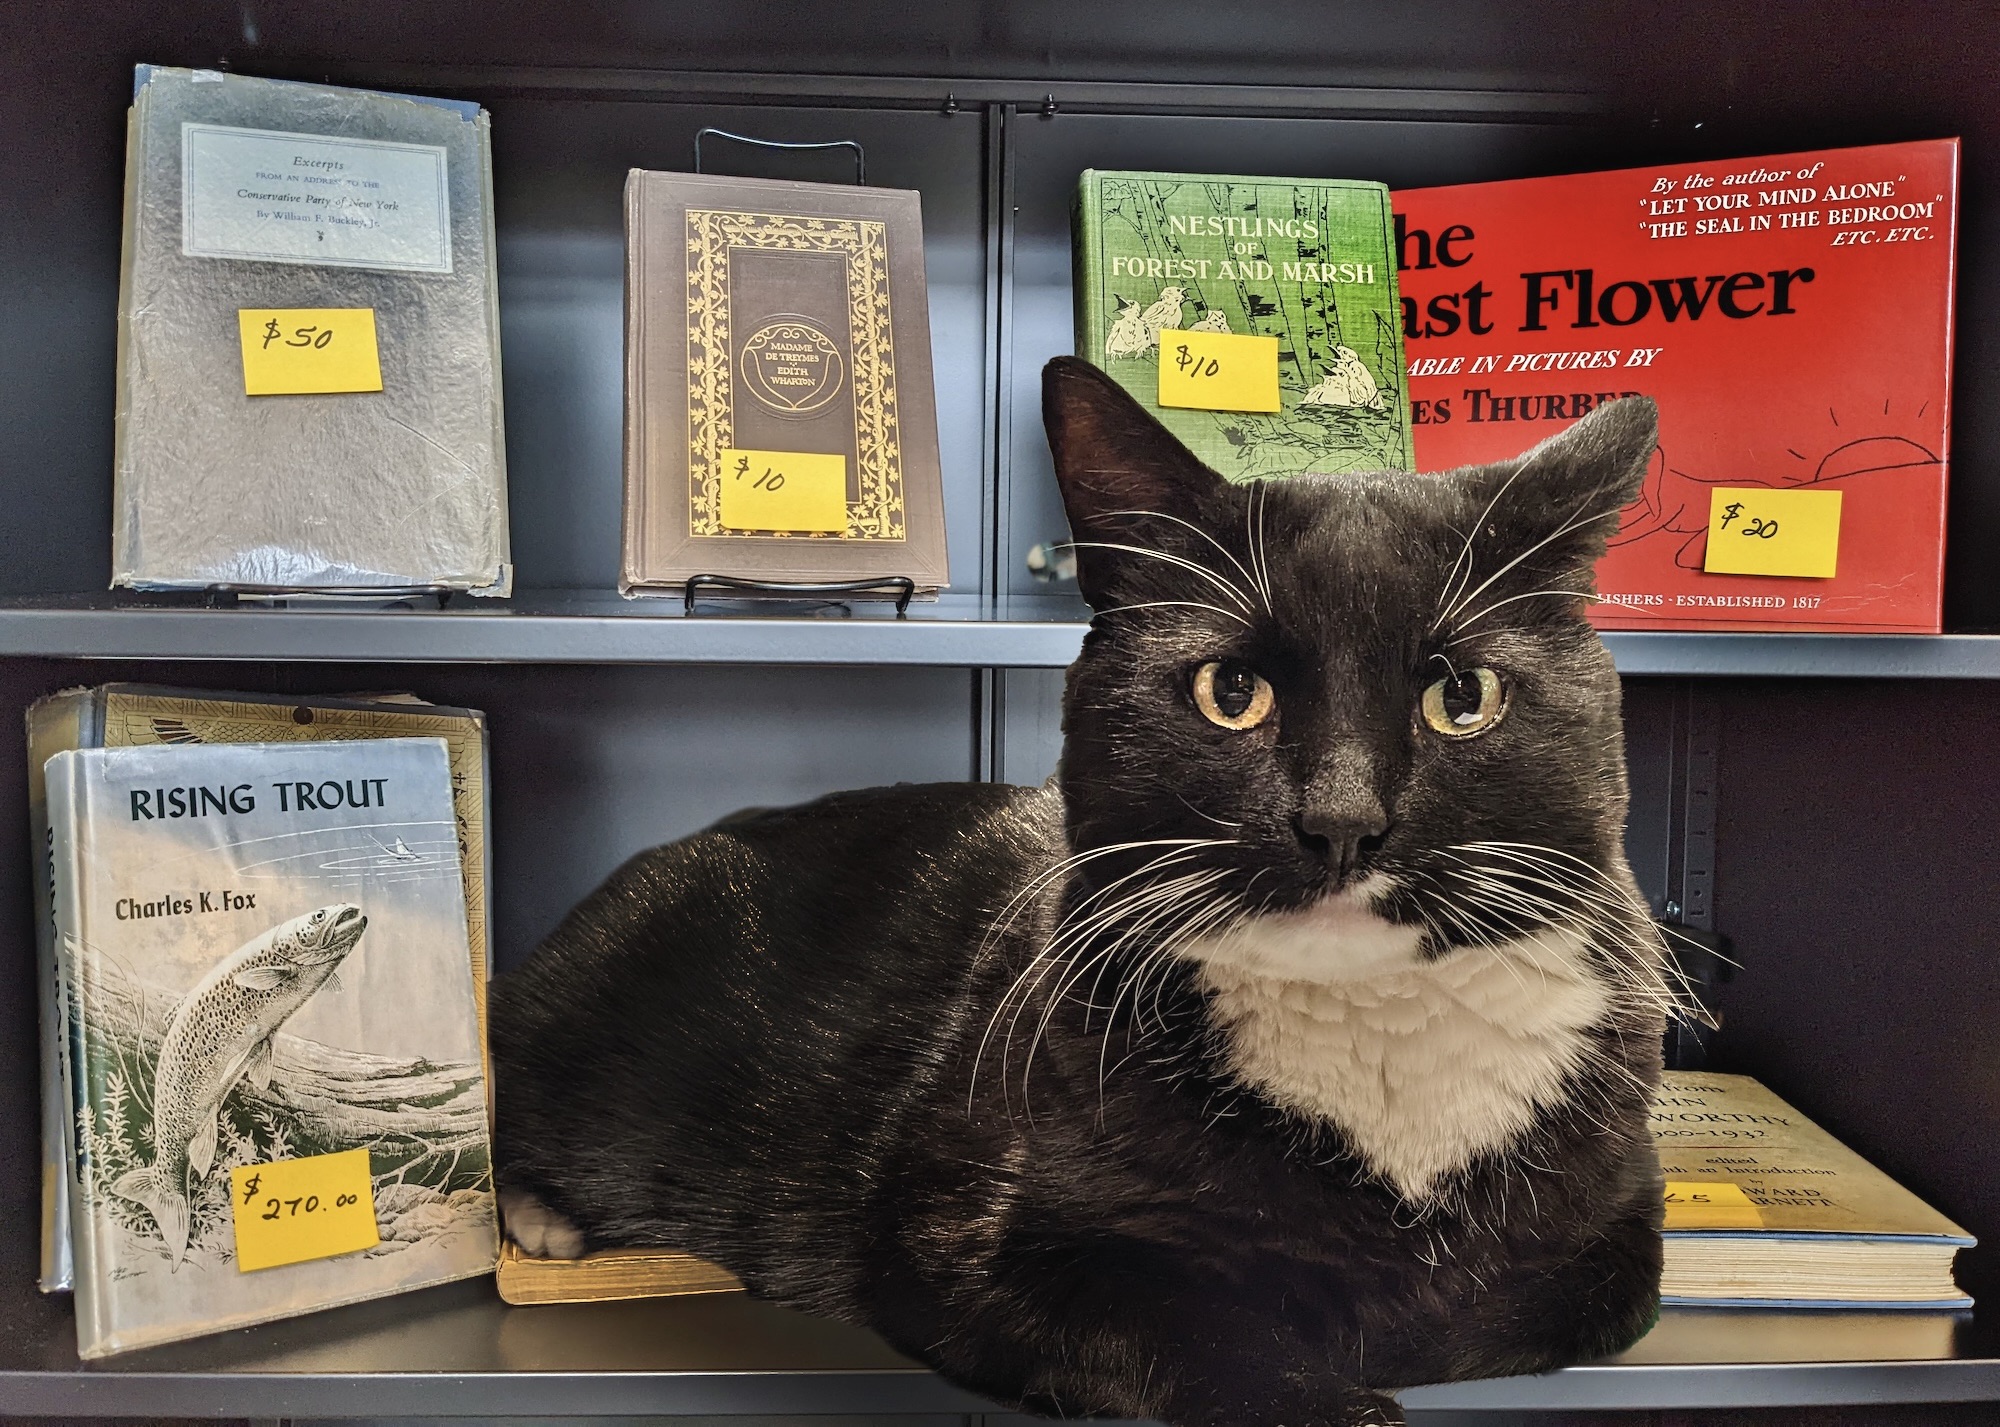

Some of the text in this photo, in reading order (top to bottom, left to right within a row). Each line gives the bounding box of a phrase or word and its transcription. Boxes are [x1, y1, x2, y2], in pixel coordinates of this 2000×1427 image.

[293, 156, 344, 172] Excerpts
[256, 172, 282, 181] FROM
[362, 181, 380, 189] THE
[1651, 162, 1824, 195] By the author of
[237, 189, 399, 211] Conservative Party of New York
[1693, 194, 1750, 212] YOUR
[1758, 187, 1816, 207] MIND
[257, 210, 270, 219] By
[273, 211, 311, 222] William
[315, 215, 324, 223] F.
[328, 216, 367, 228] Buckley,
[1170, 216, 1319, 239] NESTLINGS
[1695, 215, 1744, 236] SEAL
[1750, 214, 1770, 231] IN
[1779, 209, 1820, 229] THE
[1393, 214, 1475, 271] he
[1831, 226, 1935, 247] ETC. ETC.
[1234, 242, 1258, 255] OF
[1112, 257, 1375, 284] FOREST AND MARSH
[1400, 268, 1815, 339] ast Flower
[263, 318, 333, 349] $50
[771, 342, 813, 352] MADAME
[779, 354, 819, 363] TREYMES
[1176, 344, 1219, 378] $10
[1407, 348, 1663, 376] ABLE IN PICTURES BY
[770, 376, 815, 386] WHARTON
[777, 367, 808, 376] EDITH
[733, 456, 785, 491] $10
[1721, 503, 1779, 539] $20
[1597, 593, 1821, 609] LISHERS ESTABLISHED 1817
[130, 779, 388, 821] RISING TROUT
[116, 891, 257, 920] Charles K. Fox
[1662, 1084, 1725, 1093] from
[1657, 1098, 1707, 1106] HN
[1649, 1113, 1790, 1126] WORTHY
[1651, 1130, 1769, 1139] 900-1932
[1727, 1167, 1837, 1176] Introduction
[1741, 1187, 1821, 1197] WARD
[1750, 1198, 1833, 1206] ARNETT
